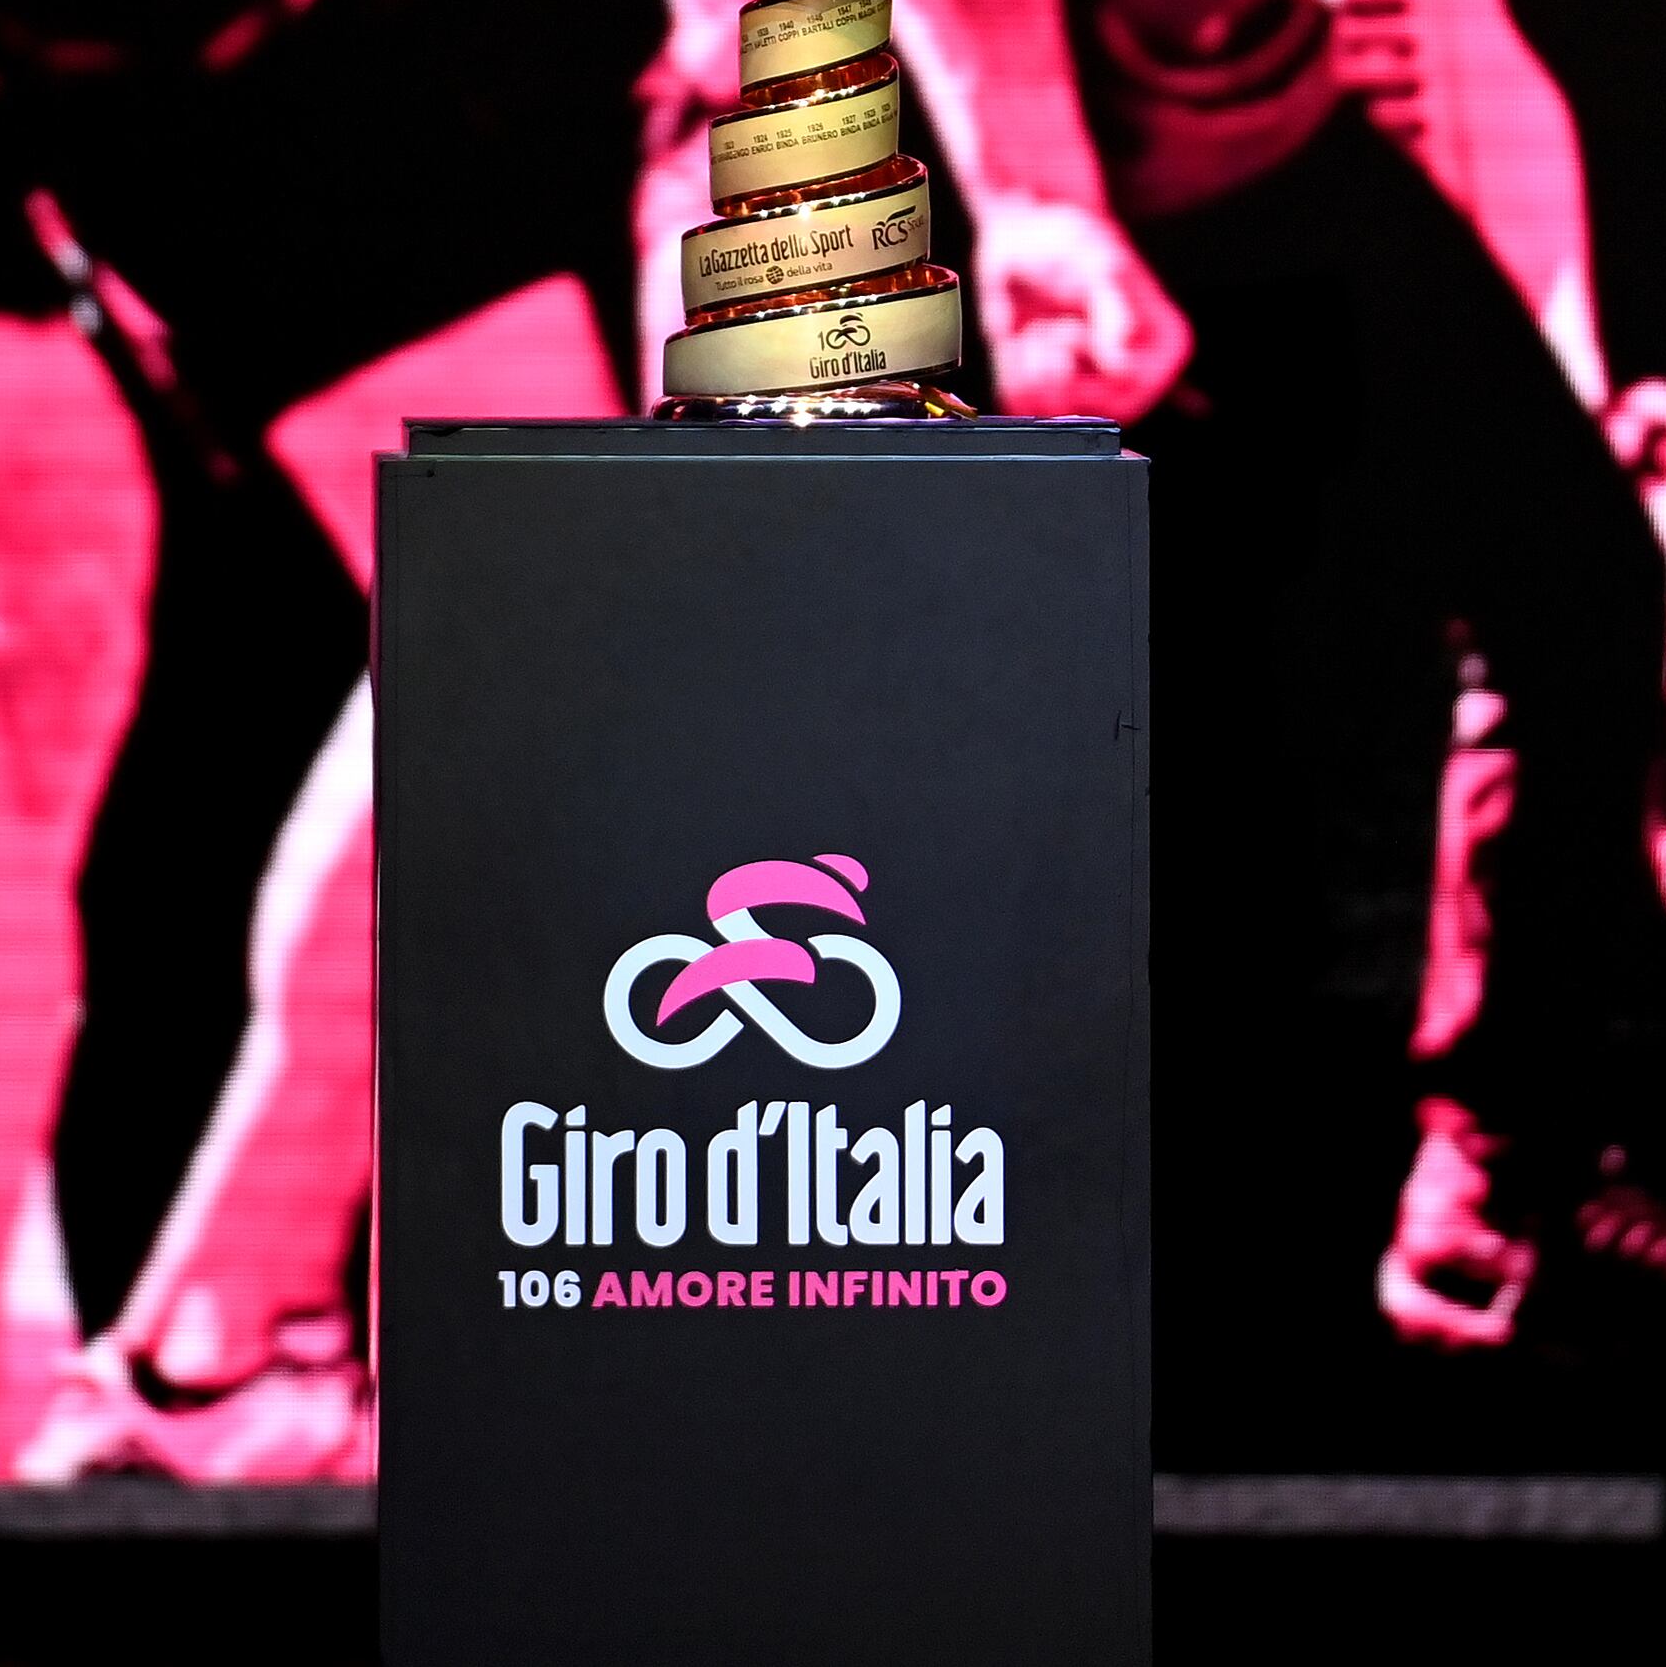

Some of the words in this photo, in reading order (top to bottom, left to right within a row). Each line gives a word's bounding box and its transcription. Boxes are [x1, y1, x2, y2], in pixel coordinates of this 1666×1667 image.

[778, 30, 800, 43] COPPI
[802, 23, 834, 36] BARTALI
[836, 14, 857, 27] COPPI
[776, 139, 799, 150] BINDA
[801, 130, 838, 145] BRUNERO
[840, 124, 861, 137] BINDA
[771, 233, 809, 262] dello
[811, 224, 854, 258] Sport
[872, 220, 909, 250] RCS
[744, 275, 764, 285] rosa
[786, 265, 812, 278] della
[813, 262, 833, 272] vita
[809, 357, 840, 379] Giro
[842, 349, 887, 375] d'Italia
[501, 1100, 687, 1248] Giro
[707, 1099, 1005, 1247] d'Italia
[498, 1270, 582, 1309] 106
[591, 1270, 775, 1308] AMORE
[788, 1270, 1008, 1309] INFINITO
